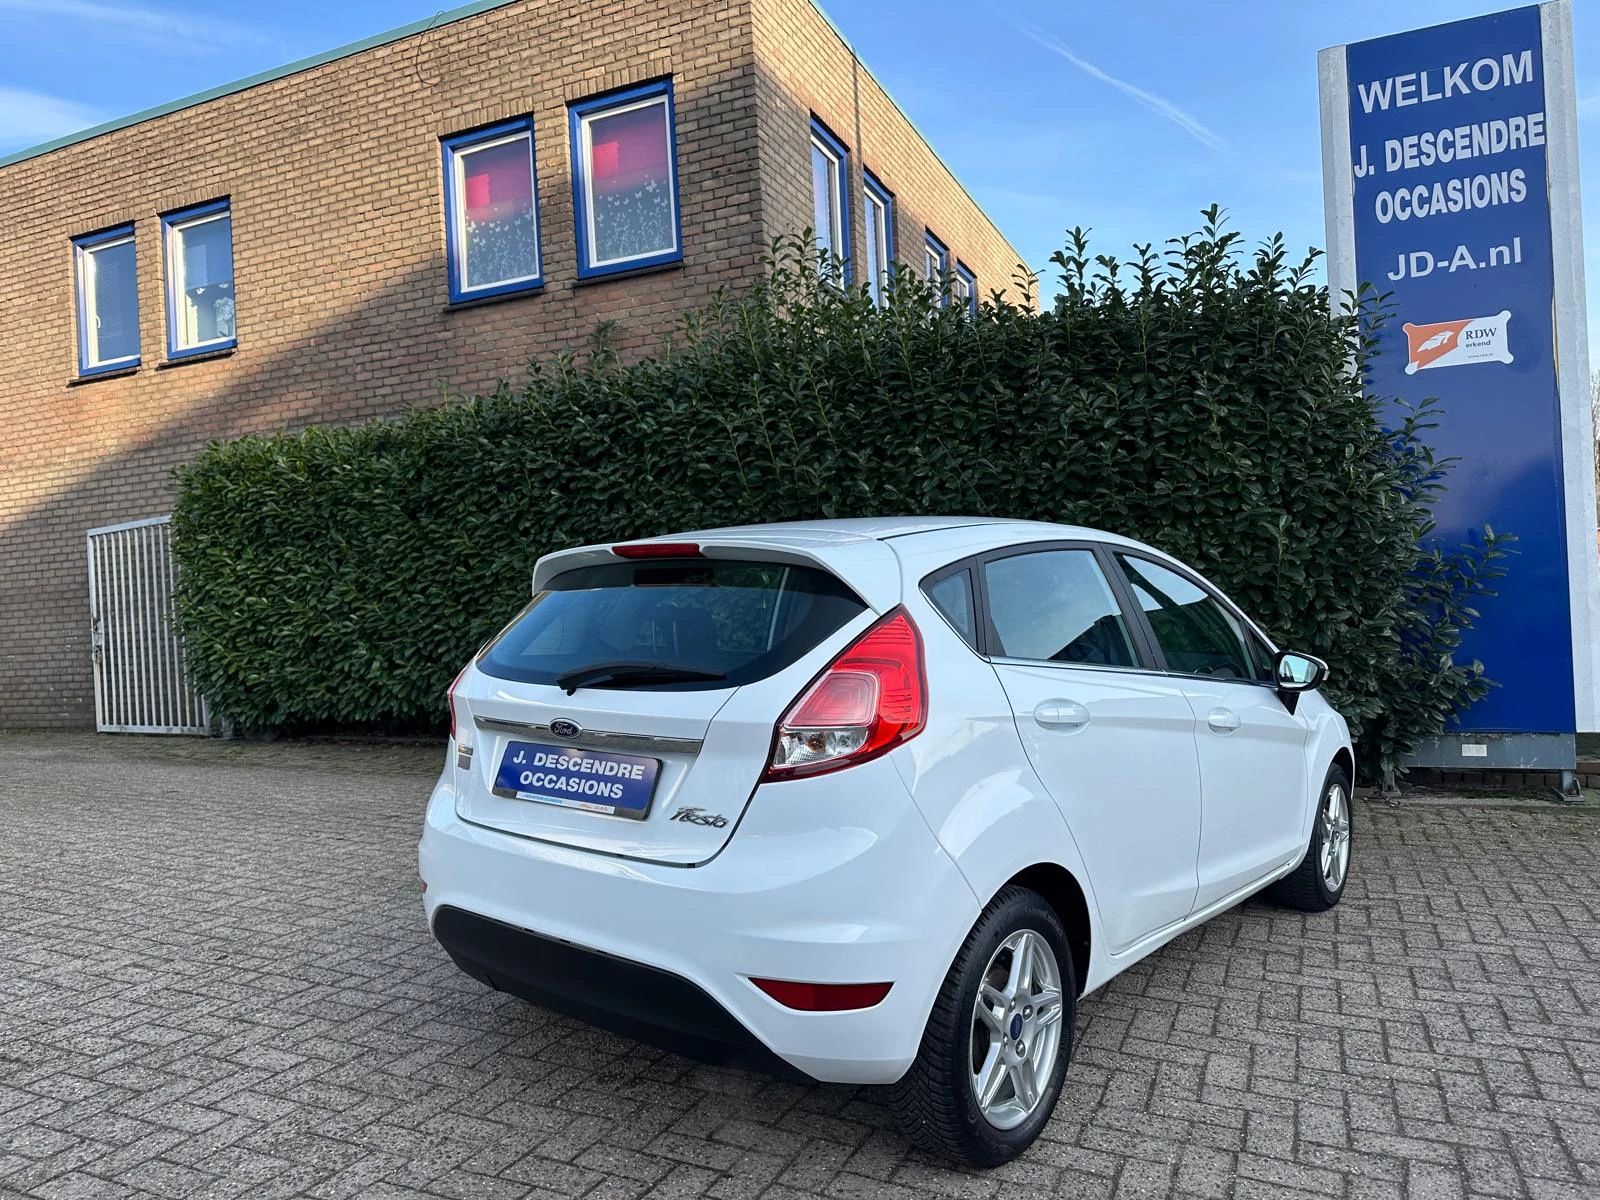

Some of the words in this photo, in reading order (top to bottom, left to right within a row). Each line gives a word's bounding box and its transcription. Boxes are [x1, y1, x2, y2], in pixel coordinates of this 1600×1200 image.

[1358, 50, 1534, 114] WELKOM
[1354, 145, 1375, 178] J.
[1385, 112, 1546, 173] DESCENDRE
[1375, 168, 1527, 224] OCCASIONS
[1387, 236, 1522, 281] JD-A.nl
[1465, 327, 1497, 340] RDW
[1465, 339, 1491, 348] erkend
[553, 722, 575, 736] Ford
[513, 750, 527, 765] J.
[533, 752, 645, 780] DESCENDRE
[519, 771, 623, 799] OCCASIONS
